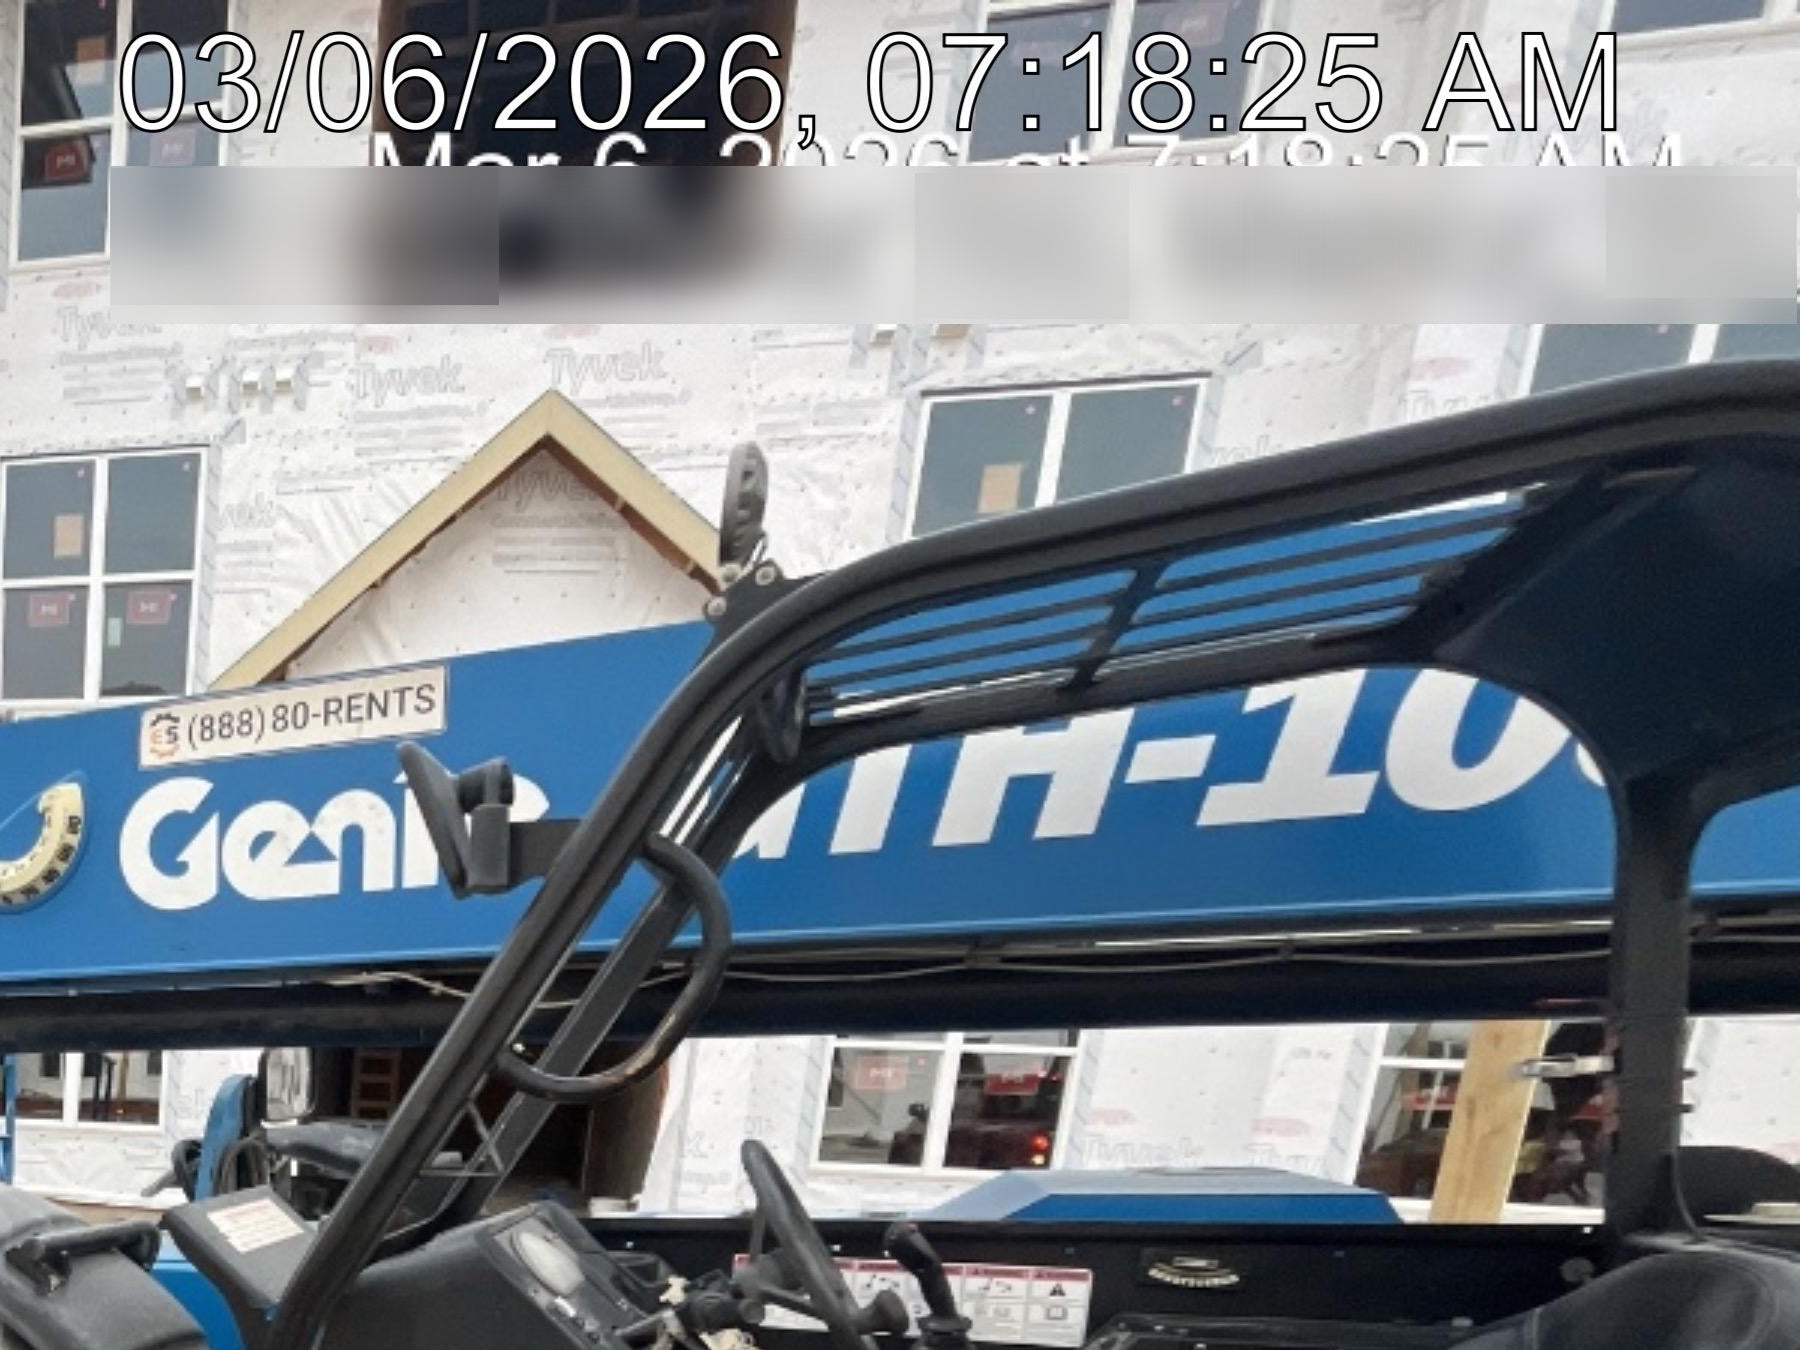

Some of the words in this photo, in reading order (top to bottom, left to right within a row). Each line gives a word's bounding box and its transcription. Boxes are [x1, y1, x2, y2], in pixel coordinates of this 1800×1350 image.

[349, 354, 466, 408] Tyvek
[543, 340, 670, 396] Tyvek
[188, 707, 265, 750] (888)
[271, 683, 437, 733] 80-RENTS
[119, 775, 552, 911] Geni
[728, 667, 1608, 859] TH-10
